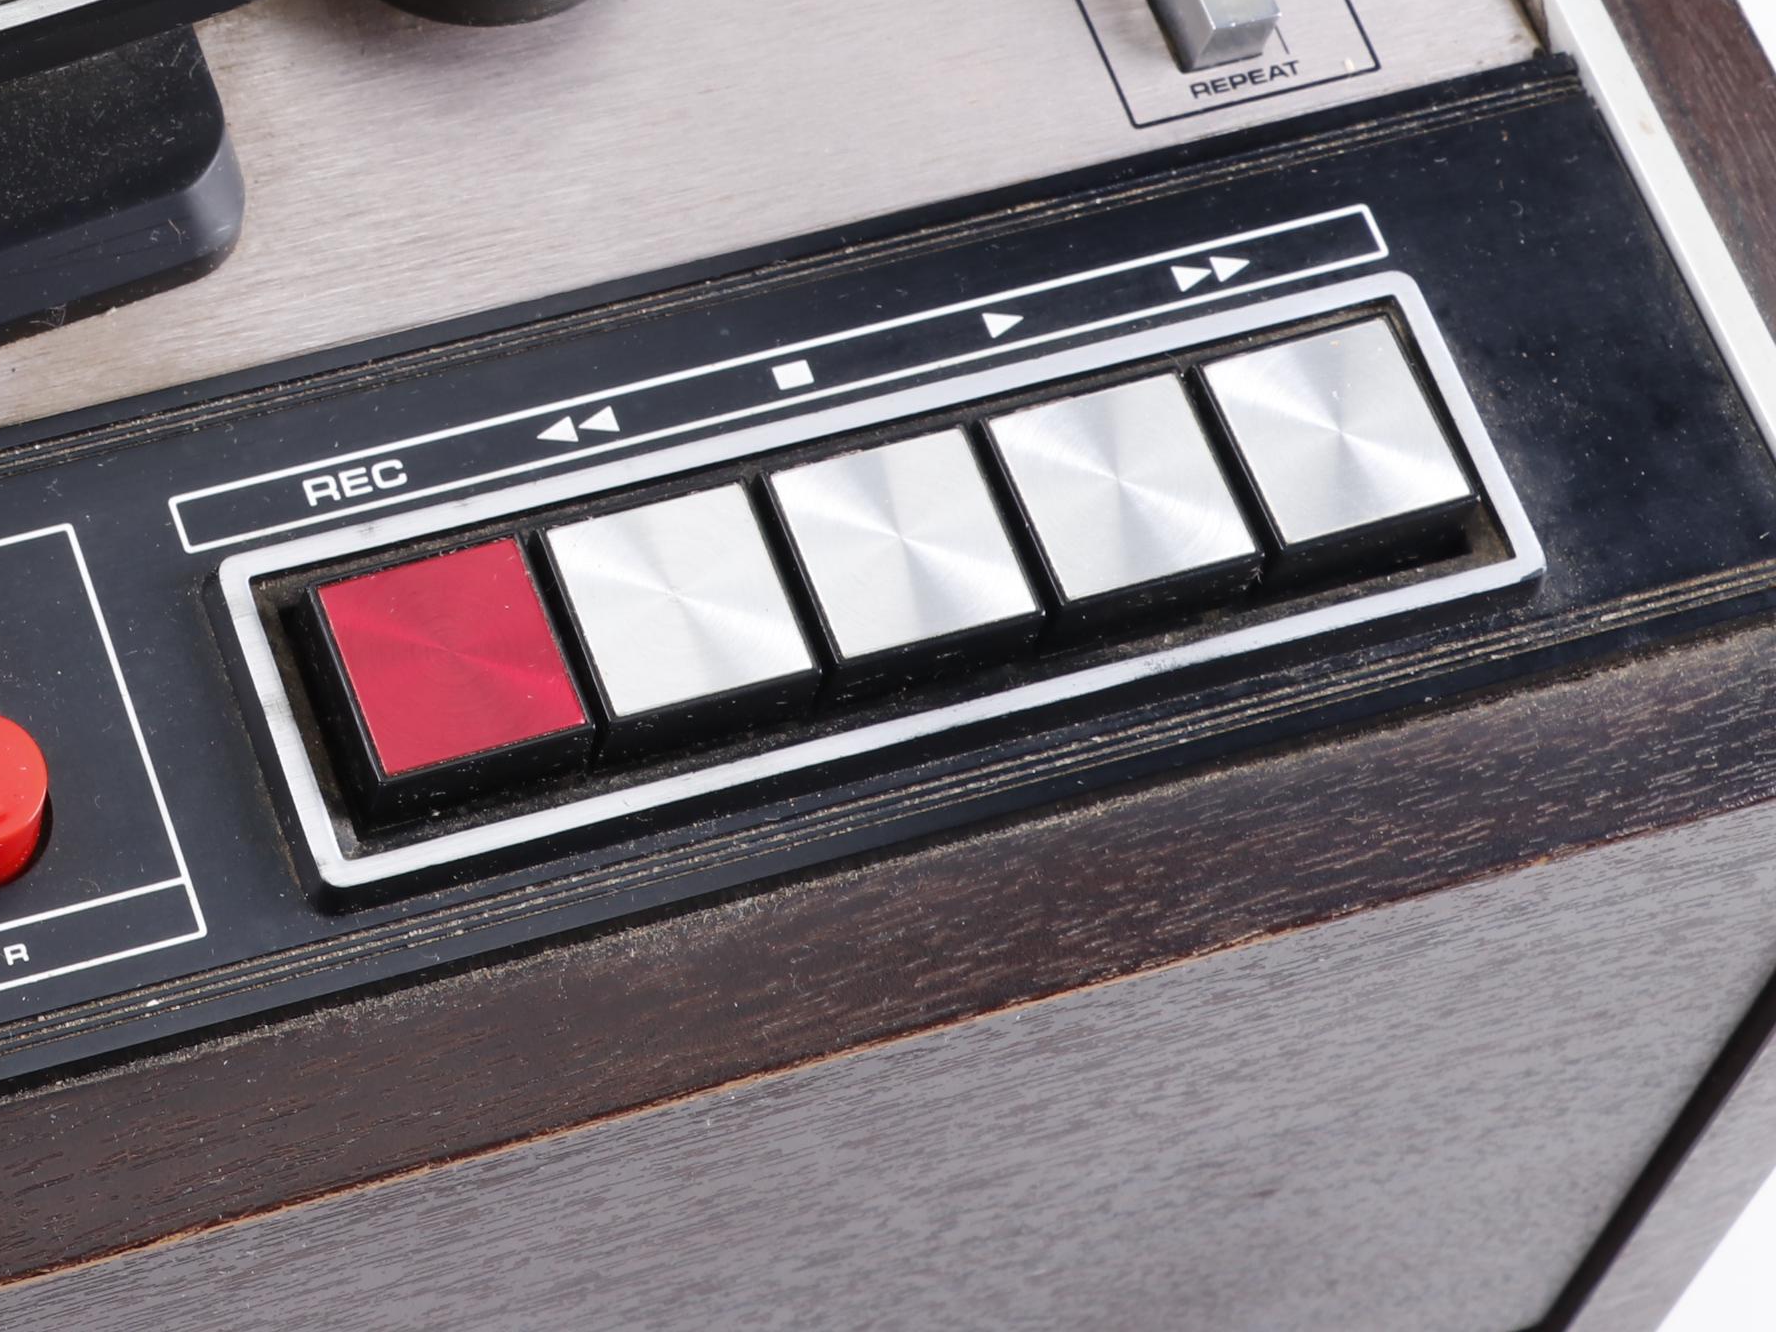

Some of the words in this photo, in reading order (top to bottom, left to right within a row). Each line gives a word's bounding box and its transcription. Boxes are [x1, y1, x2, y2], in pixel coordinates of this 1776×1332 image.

[1188, 60, 1301, 99] REPEAT
[302, 458, 408, 507] REC
[3, 943, 30, 966] R
